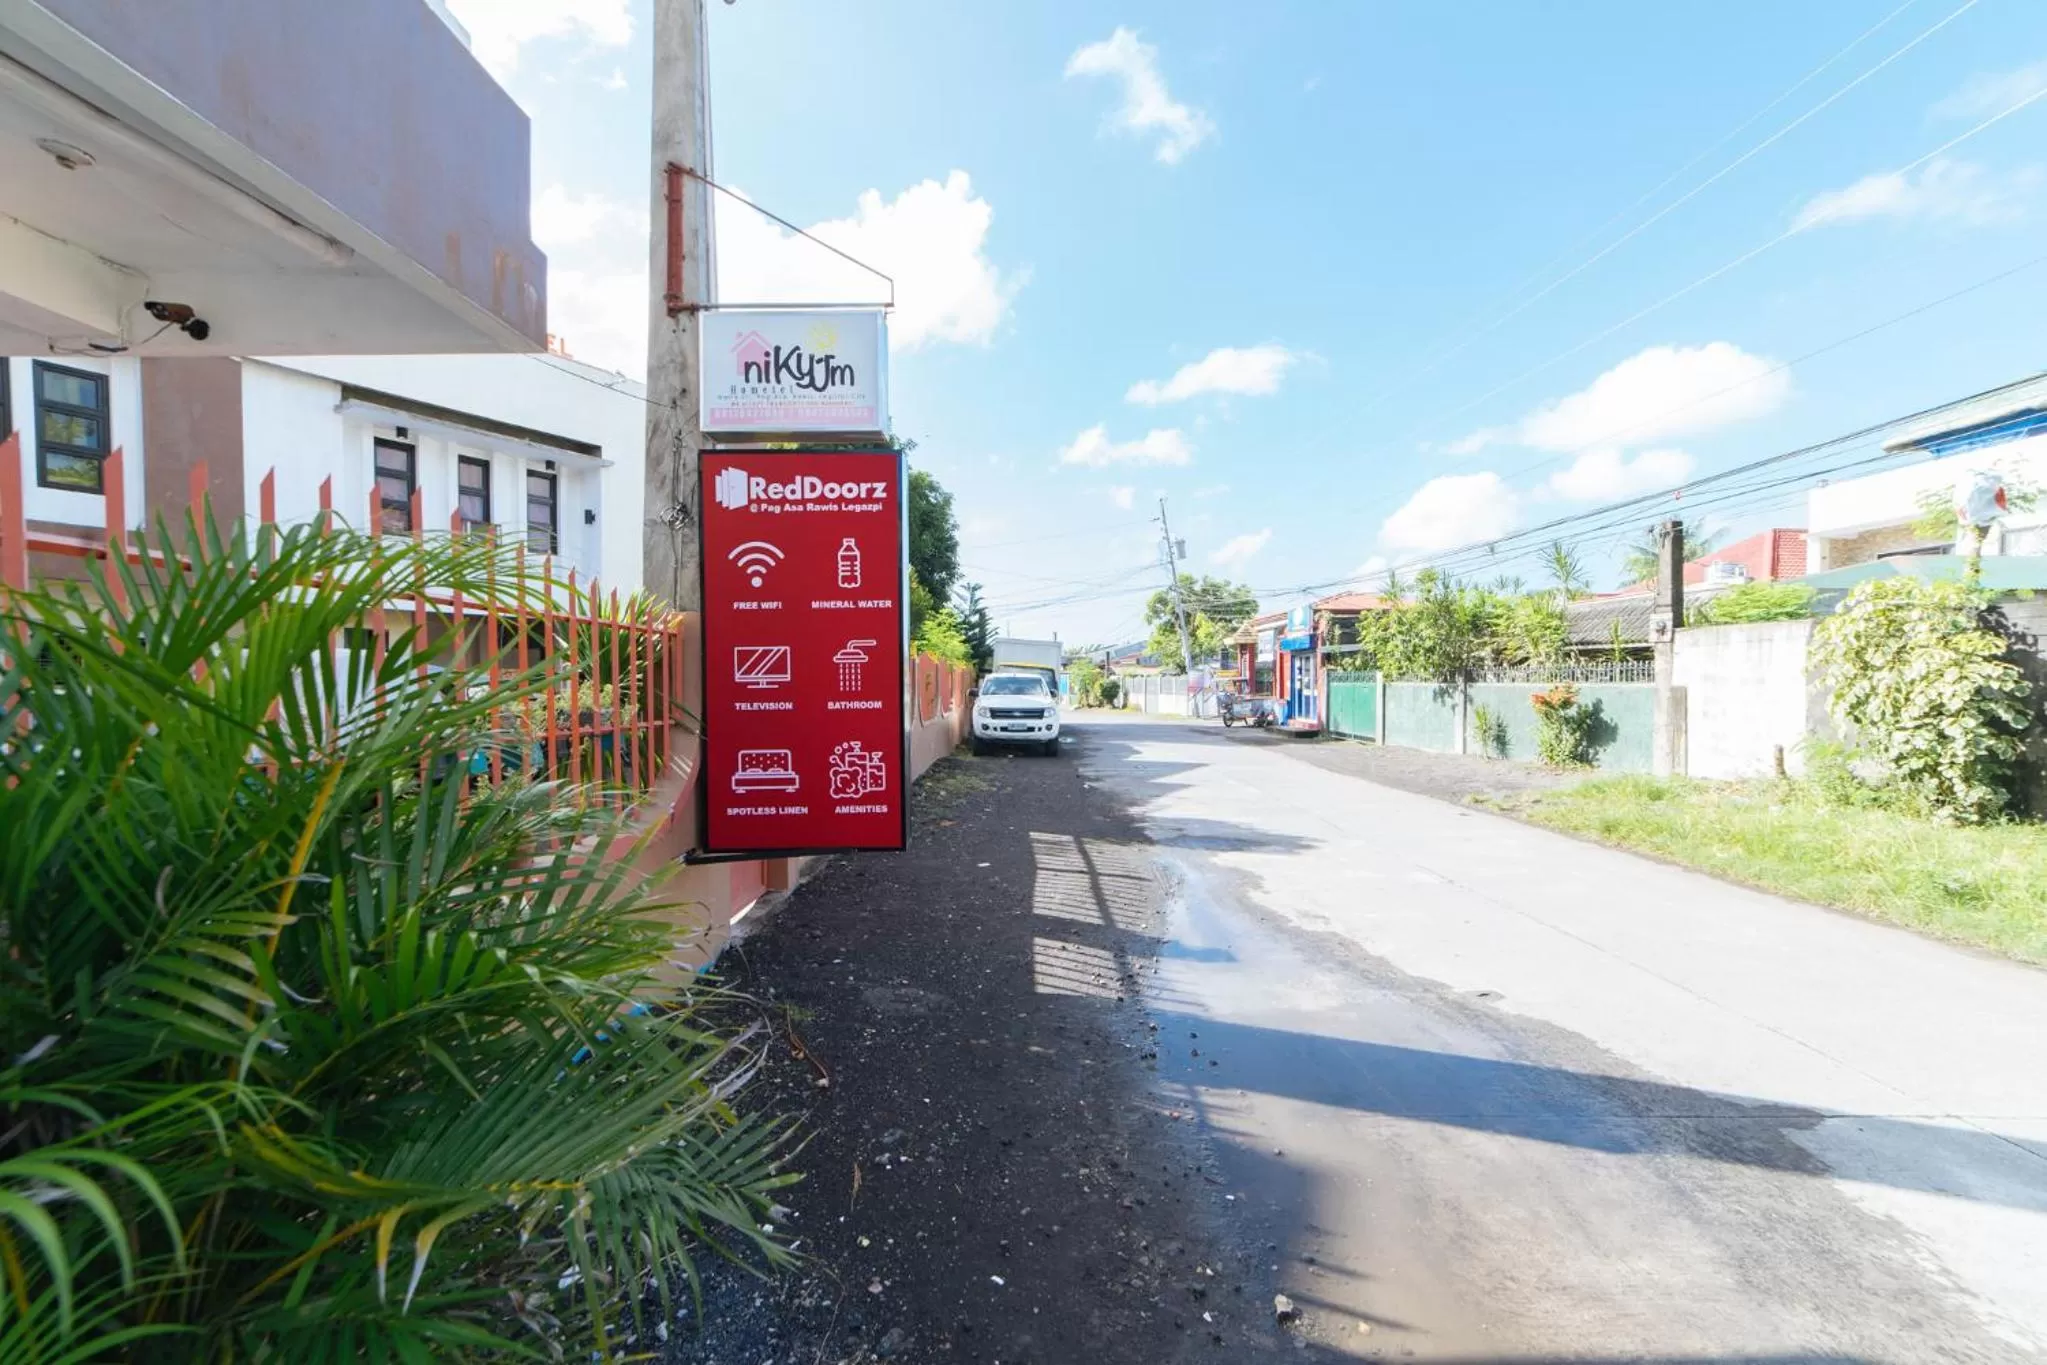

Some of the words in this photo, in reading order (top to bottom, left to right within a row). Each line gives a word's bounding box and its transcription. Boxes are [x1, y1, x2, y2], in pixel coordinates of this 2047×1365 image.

[749, 476, 888, 500] RedDoorz
[761, 503, 781, 514] Pag
[784, 503, 804, 512] Asa
[806, 503, 839, 512] Rawis
[841, 502, 883, 513] Legazpi
[733, 601, 759, 610] FREE
[761, 601, 783, 610] WIFI
[811, 600, 855, 610] MINERAL
[858, 599, 893, 609] WATER
[734, 702, 794, 711] TELEVISION
[827, 700, 883, 710] BATHROOM
[726, 806, 777, 816] SPOTLESS
[778, 806, 809, 815] LINEN
[834, 804, 888, 814] AMENITIES
